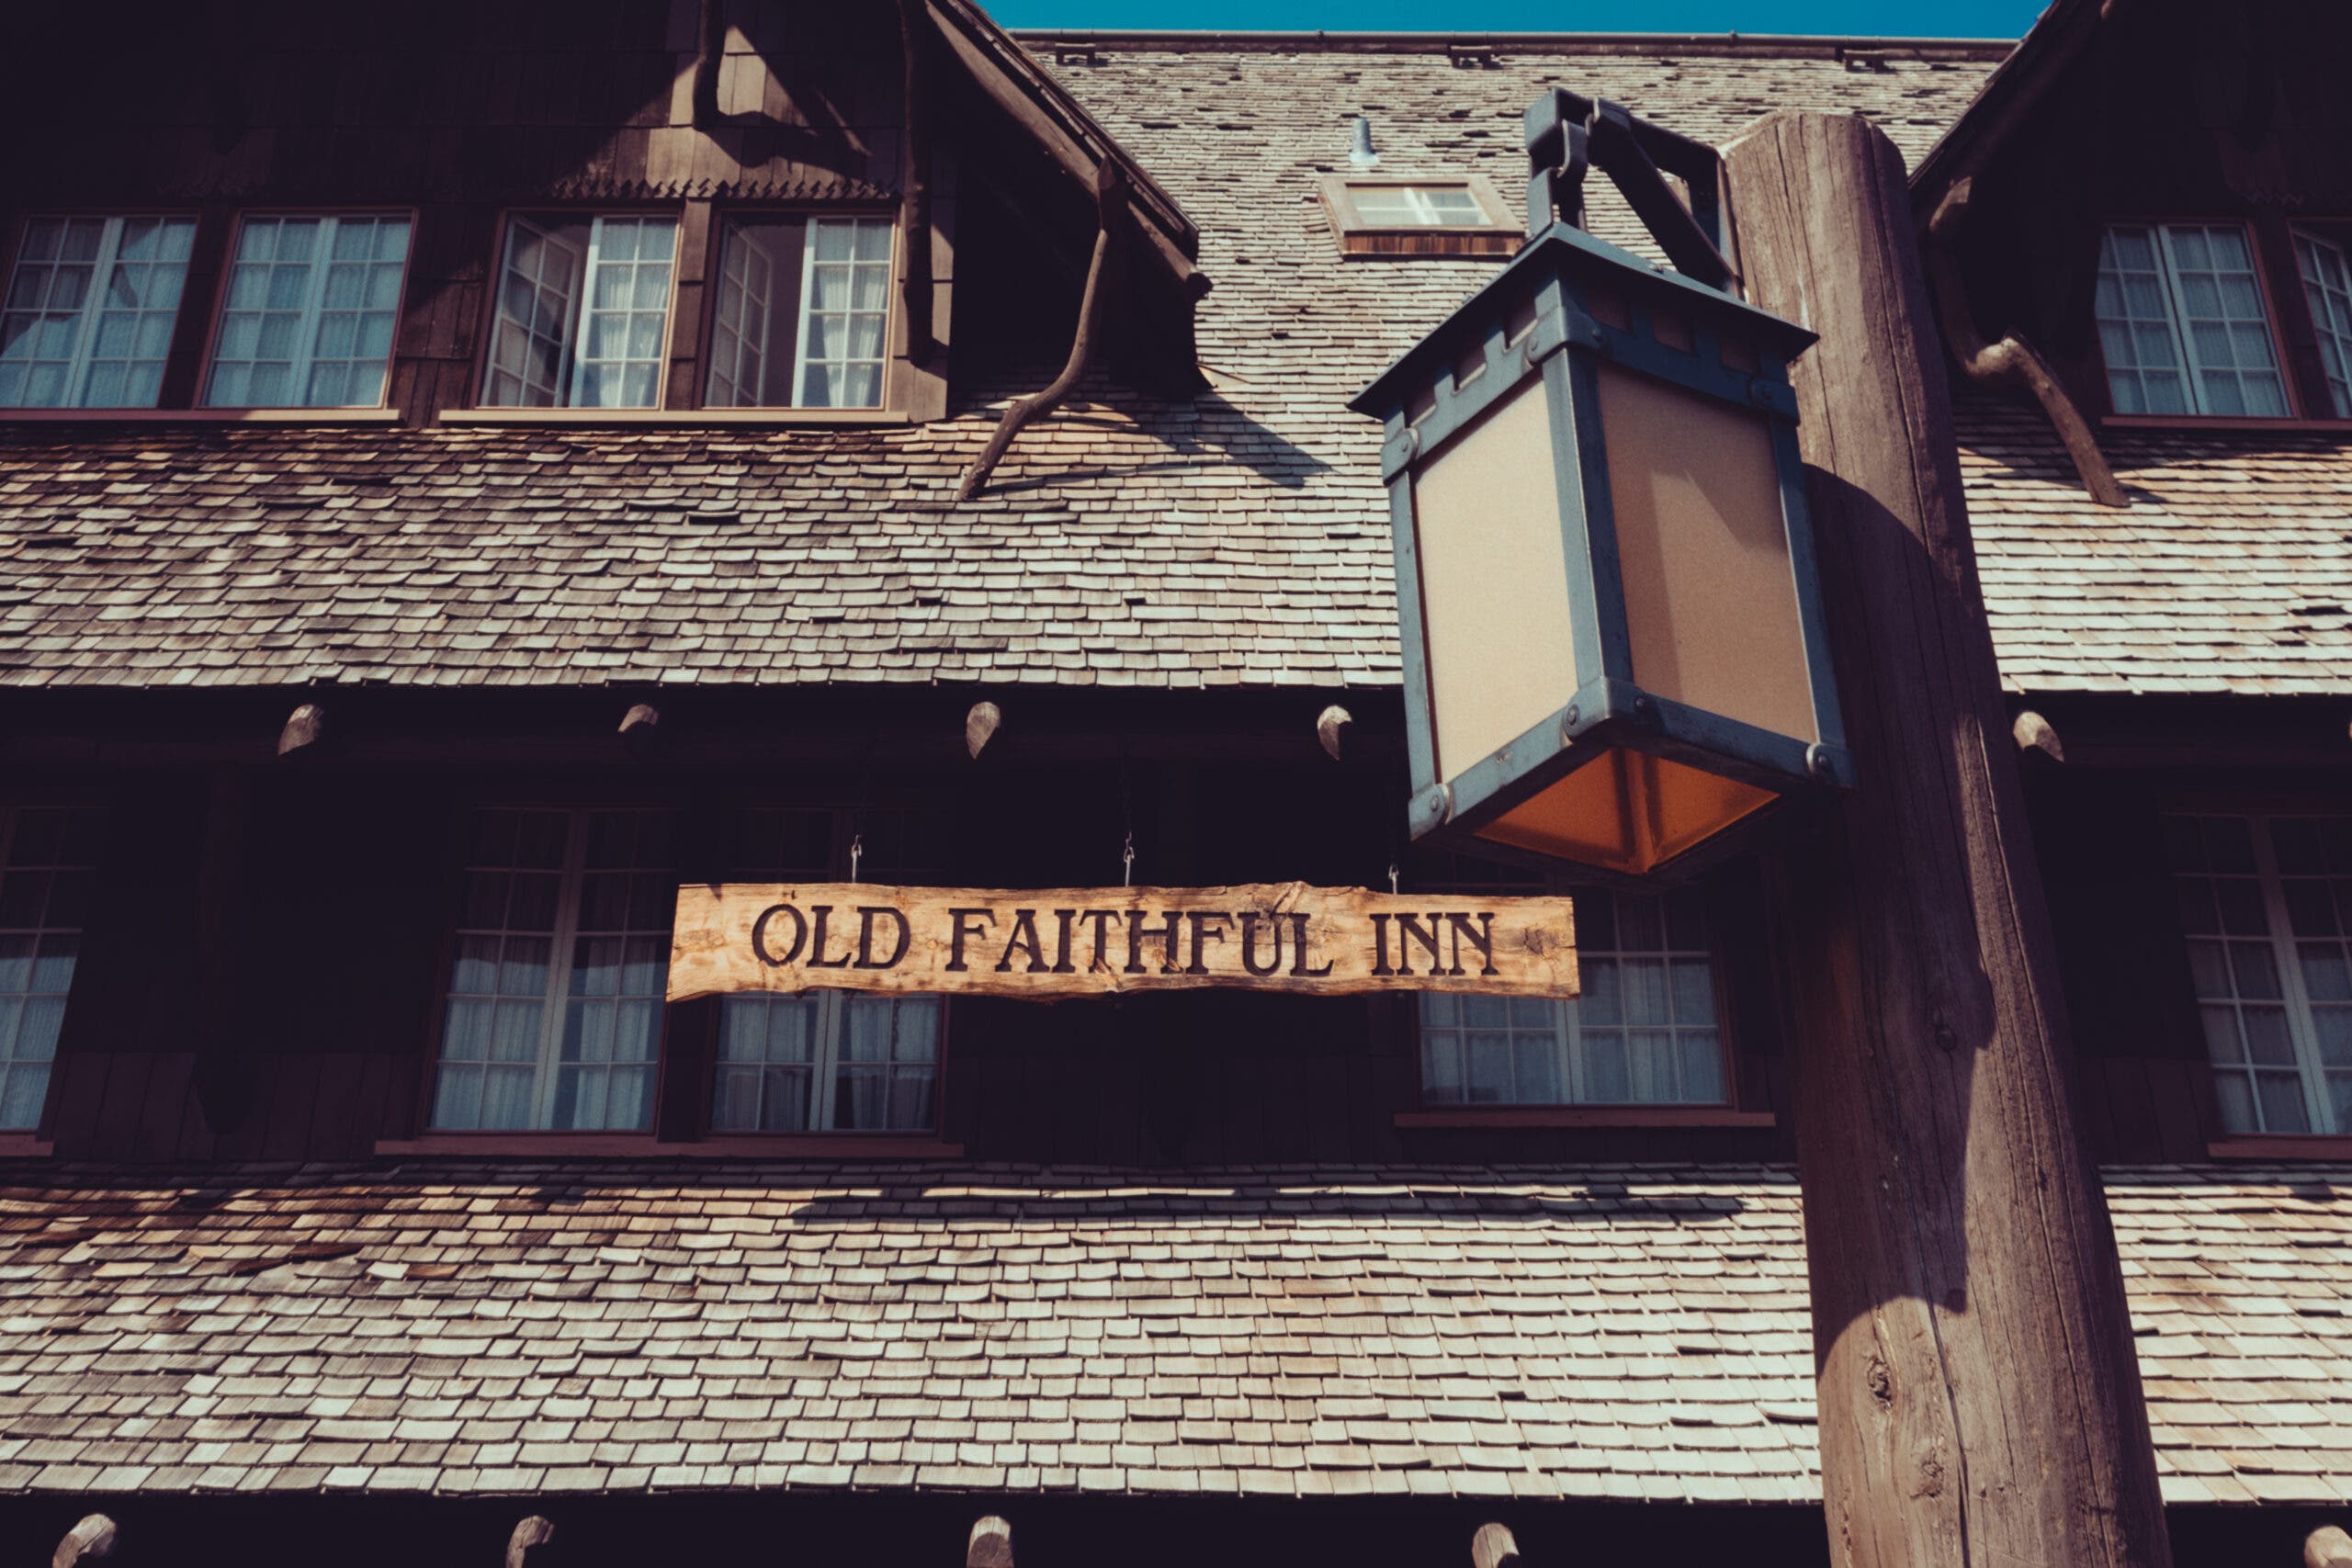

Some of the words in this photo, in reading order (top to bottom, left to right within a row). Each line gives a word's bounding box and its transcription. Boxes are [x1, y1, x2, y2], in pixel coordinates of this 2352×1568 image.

[752, 903, 911, 970] OLD
[944, 908, 1335, 977] FAITHFUL
[1369, 912, 1499, 976] INN
